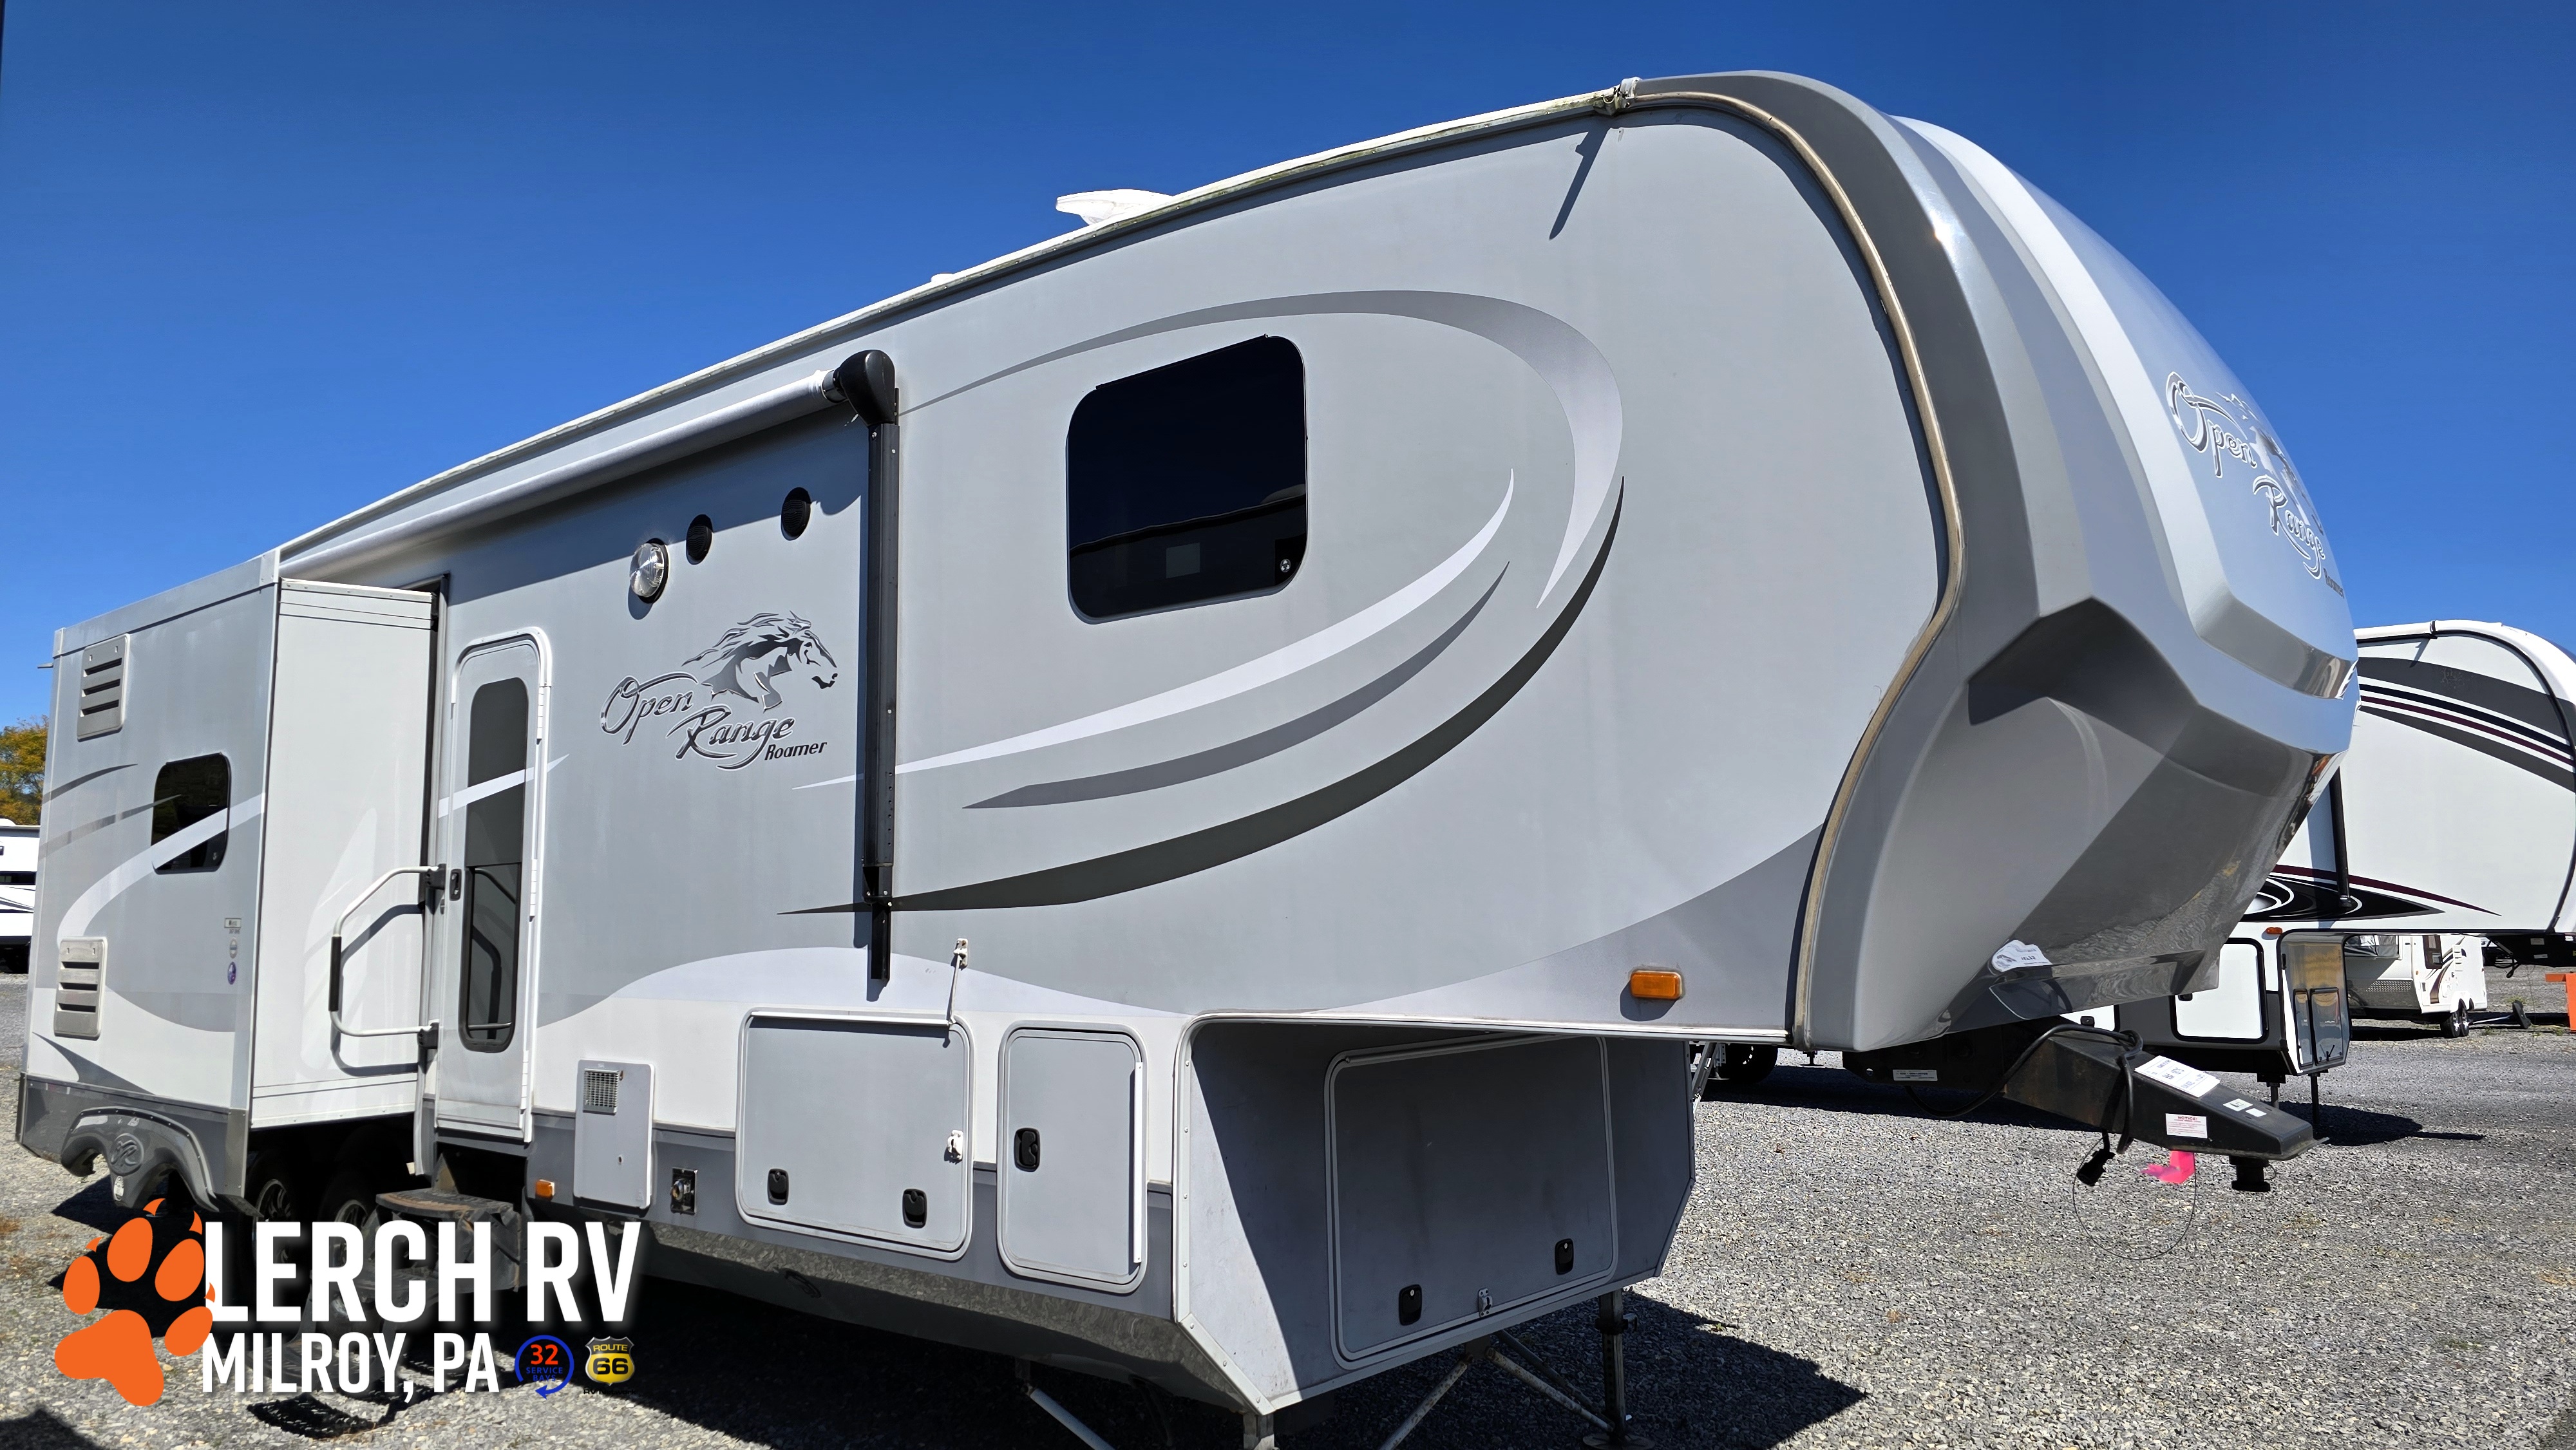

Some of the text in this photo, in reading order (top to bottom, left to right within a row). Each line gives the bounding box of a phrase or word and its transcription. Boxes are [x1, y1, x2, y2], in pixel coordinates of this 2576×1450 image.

[2166, 372, 2257, 478] Open
[600, 672, 697, 746] Open
[665, 704, 795, 771] Range
[764, 741, 828, 760] Roamer
